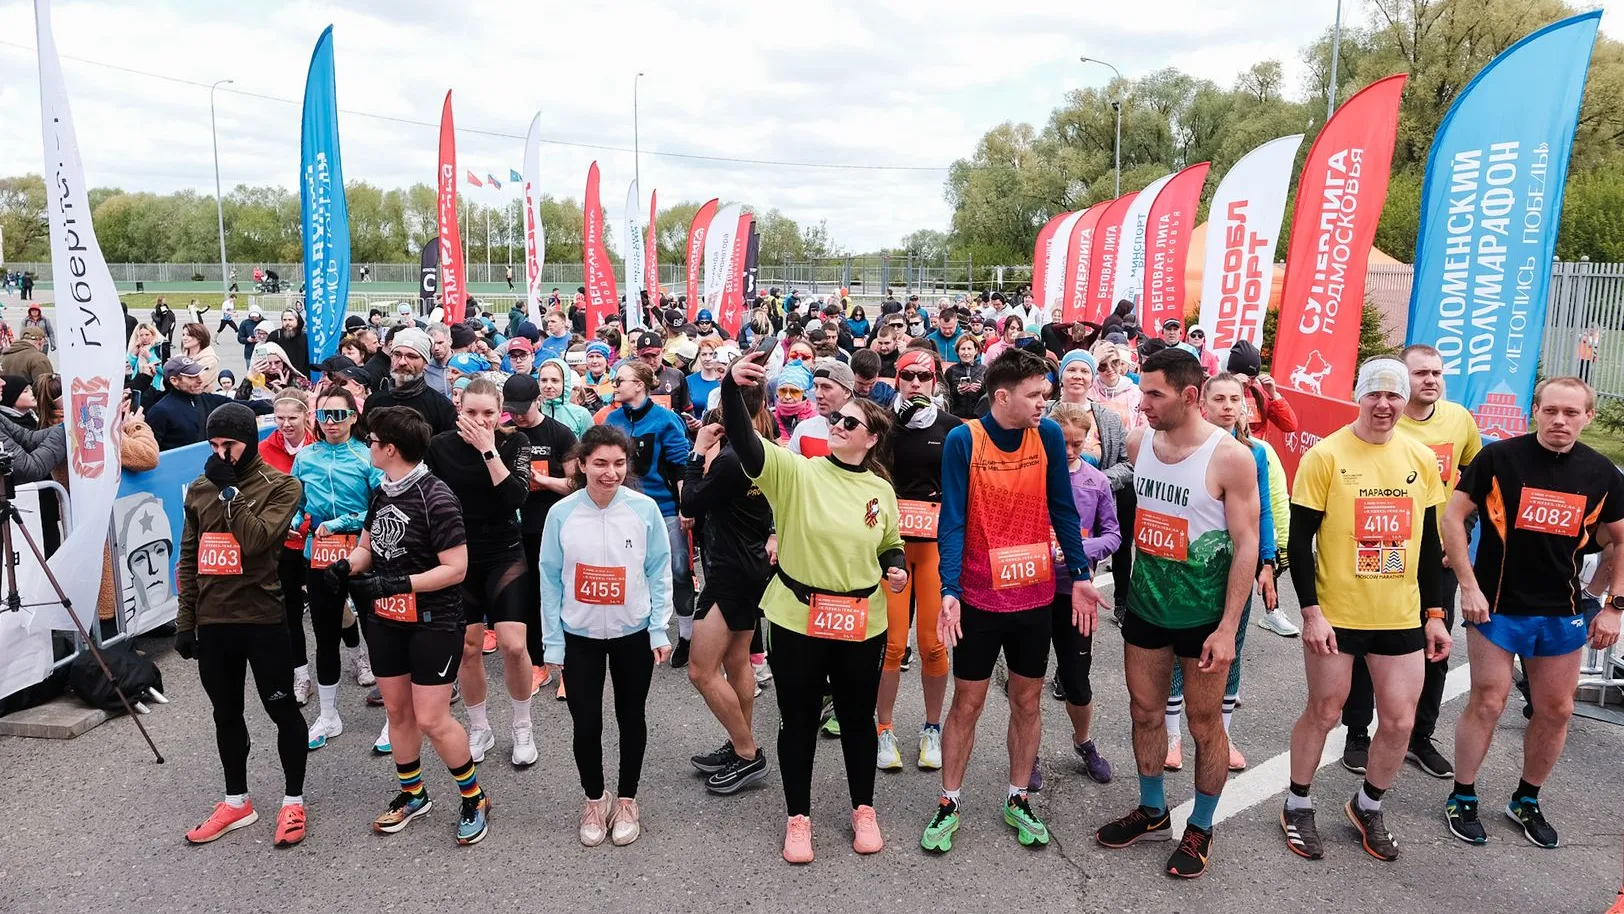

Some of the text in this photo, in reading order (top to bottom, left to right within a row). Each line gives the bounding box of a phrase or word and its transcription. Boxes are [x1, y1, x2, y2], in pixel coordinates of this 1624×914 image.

[1104, 225, 1117, 251] ЛИГА
[1130, 214, 1146, 278] МИНСПОРТ
[1166, 211, 1181, 310] ПОДМОСКОВЬЯ
[1299, 149, 1348, 334] СУПЕРЛИГА
[1322, 149, 1364, 334] ПОДМОСКОВЬЯ
[1468, 141, 1520, 374] ПОЛУМАРАФОН
[1505, 142, 1549, 373] «ЛЕТОПИСЬ ПОБЕДЫ»
[1073, 228, 1091, 308] СУПЕРЛИГА
[1097, 254, 1113, 299] БЕГОВАЯ
[1152, 214, 1170, 311] БЕГОВАЯ ЛИГА
[1213, 200, 1248, 349] МОСОБЛ
[1435, 149, 1482, 375] КОЛОМЕНСКИЙ
[1236, 232, 1268, 342] СПОРТ
[1360, 489, 1408, 497] МАРАФОН
[898, 515, 932, 530] 4032
[1138, 527, 1174, 550] 4104
[1364, 515, 1399, 532] 4116
[1522, 505, 1572, 527] 4082
[201, 549, 238, 566] 4063
[314, 548, 347, 562] 4060
[1000, 562, 1035, 580] 4118
[580, 581, 620, 597] 4155
[814, 612, 855, 631] 4128
